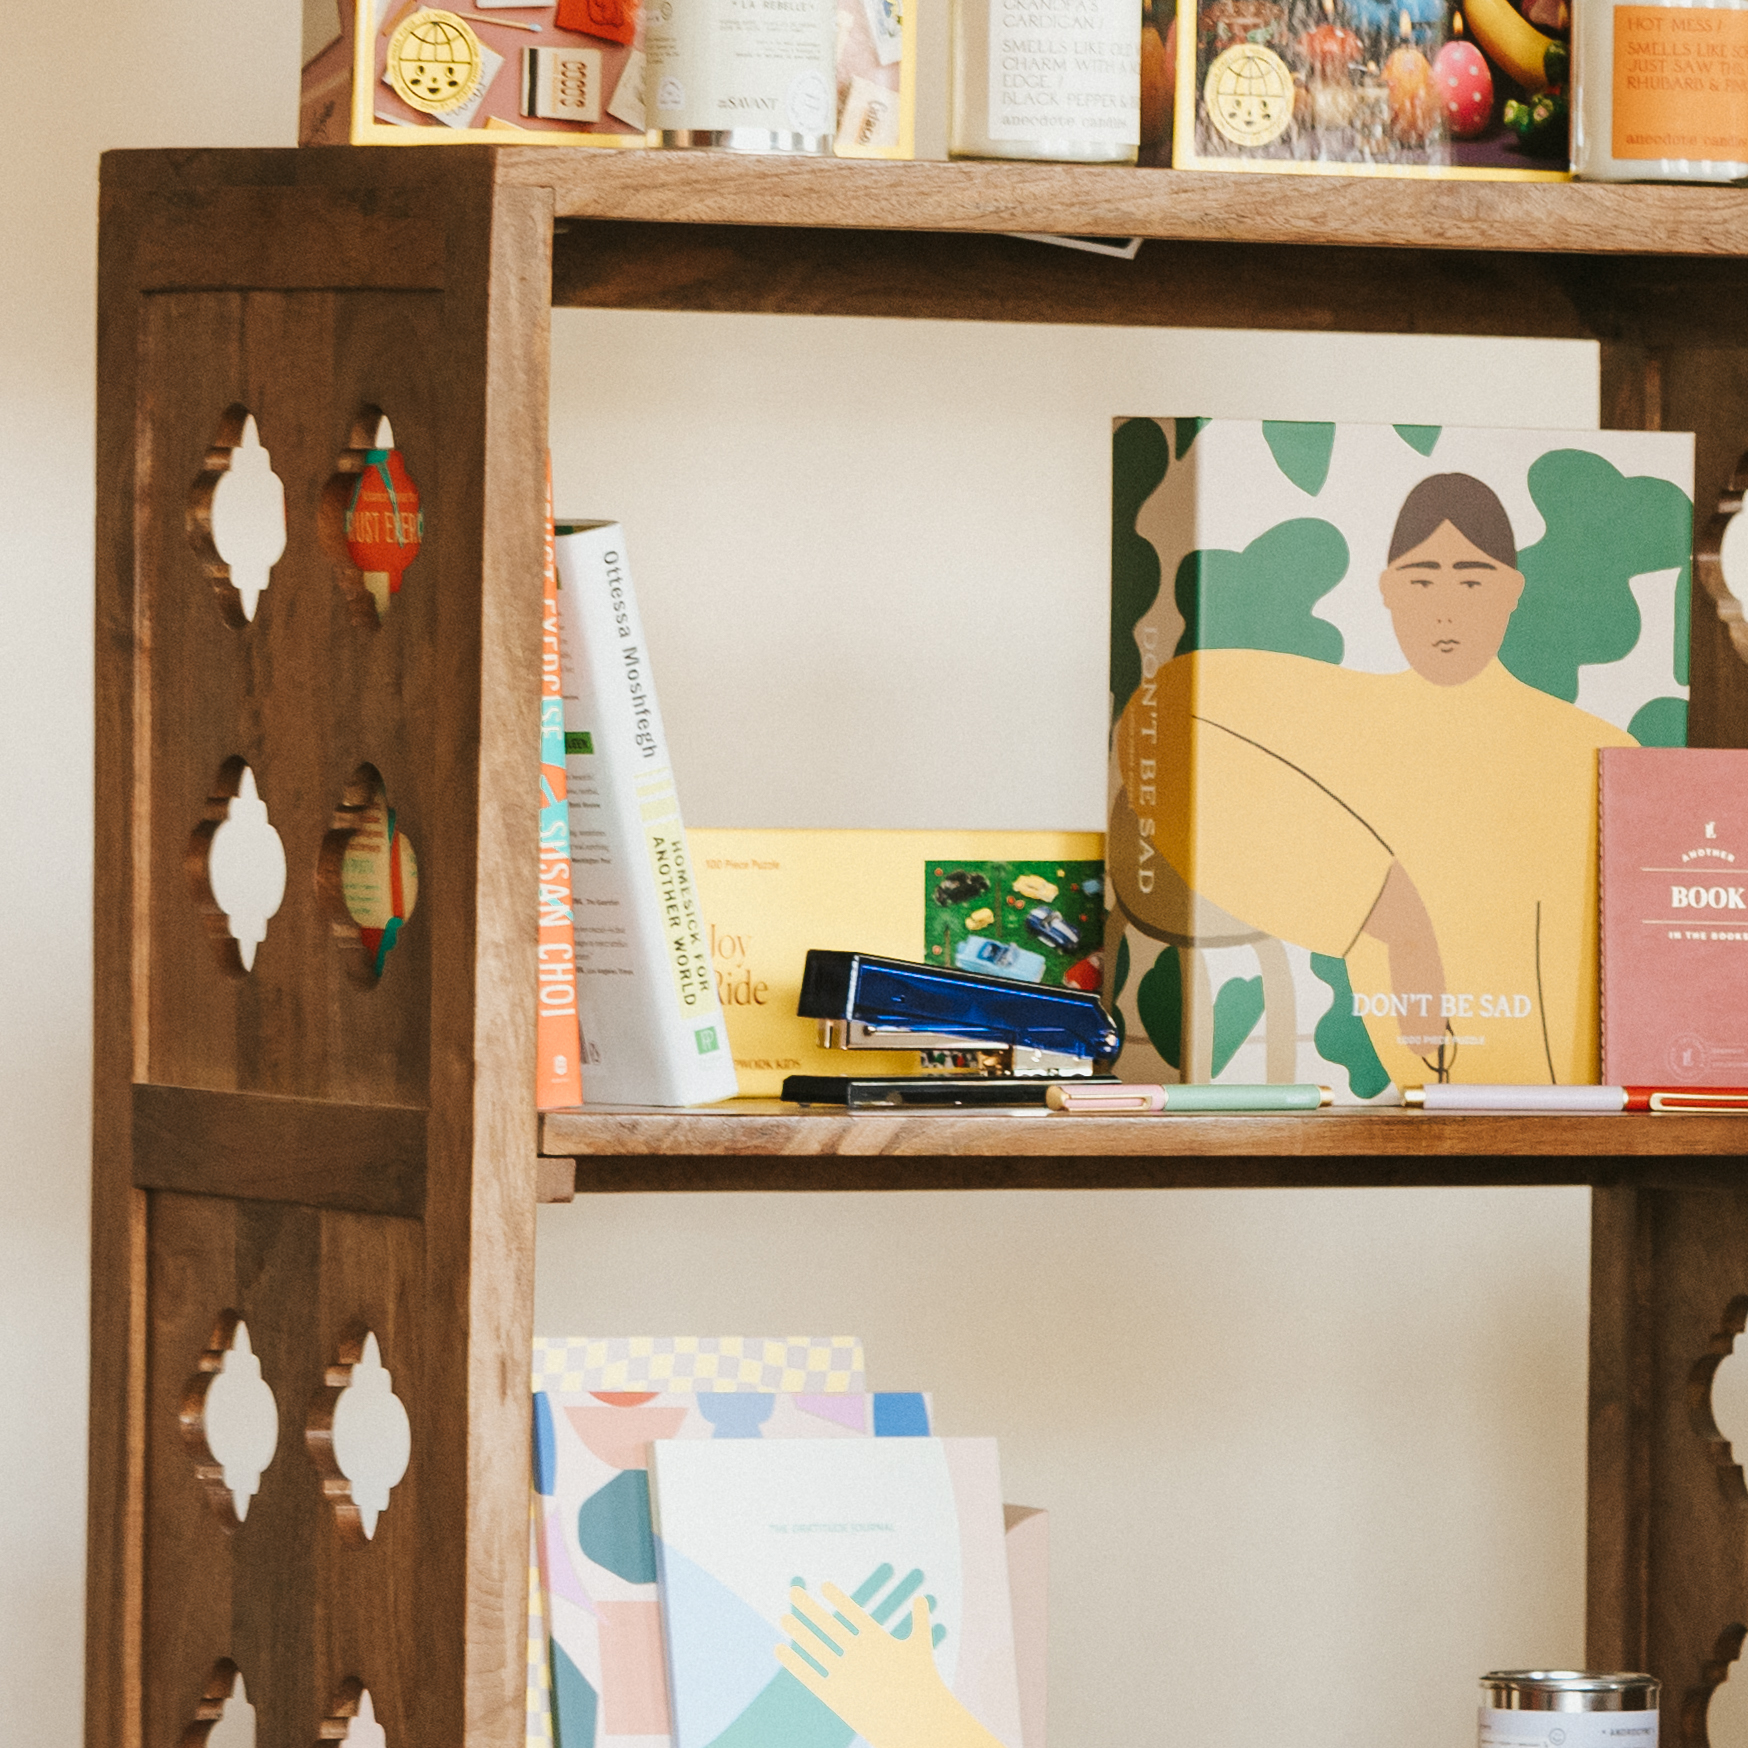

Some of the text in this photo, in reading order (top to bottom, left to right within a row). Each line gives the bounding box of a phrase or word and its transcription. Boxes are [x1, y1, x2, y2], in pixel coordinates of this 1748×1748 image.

[1628, 17, 1664, 31] HOT
[1003, 40, 1068, 54] SMELLS
[603, 549, 659, 759] Ottessa Moshfegh
[1138, 758, 1157, 807] BE
[1137, 817, 1157, 894] SAD
[1681, 847, 1736, 863] ANOTHER
[670, 840, 710, 992] HOMESICK FOR
[1670, 885, 1747, 910] BOOK
[537, 819, 577, 1019] SUSAN CHOI
[652, 836, 697, 1007] ANOTHER WORLD
[1667, 930, 1683, 940] IN
[1685, 930, 1708, 941] THE
[1351, 992, 1533, 1019] DON'T BE SAD
